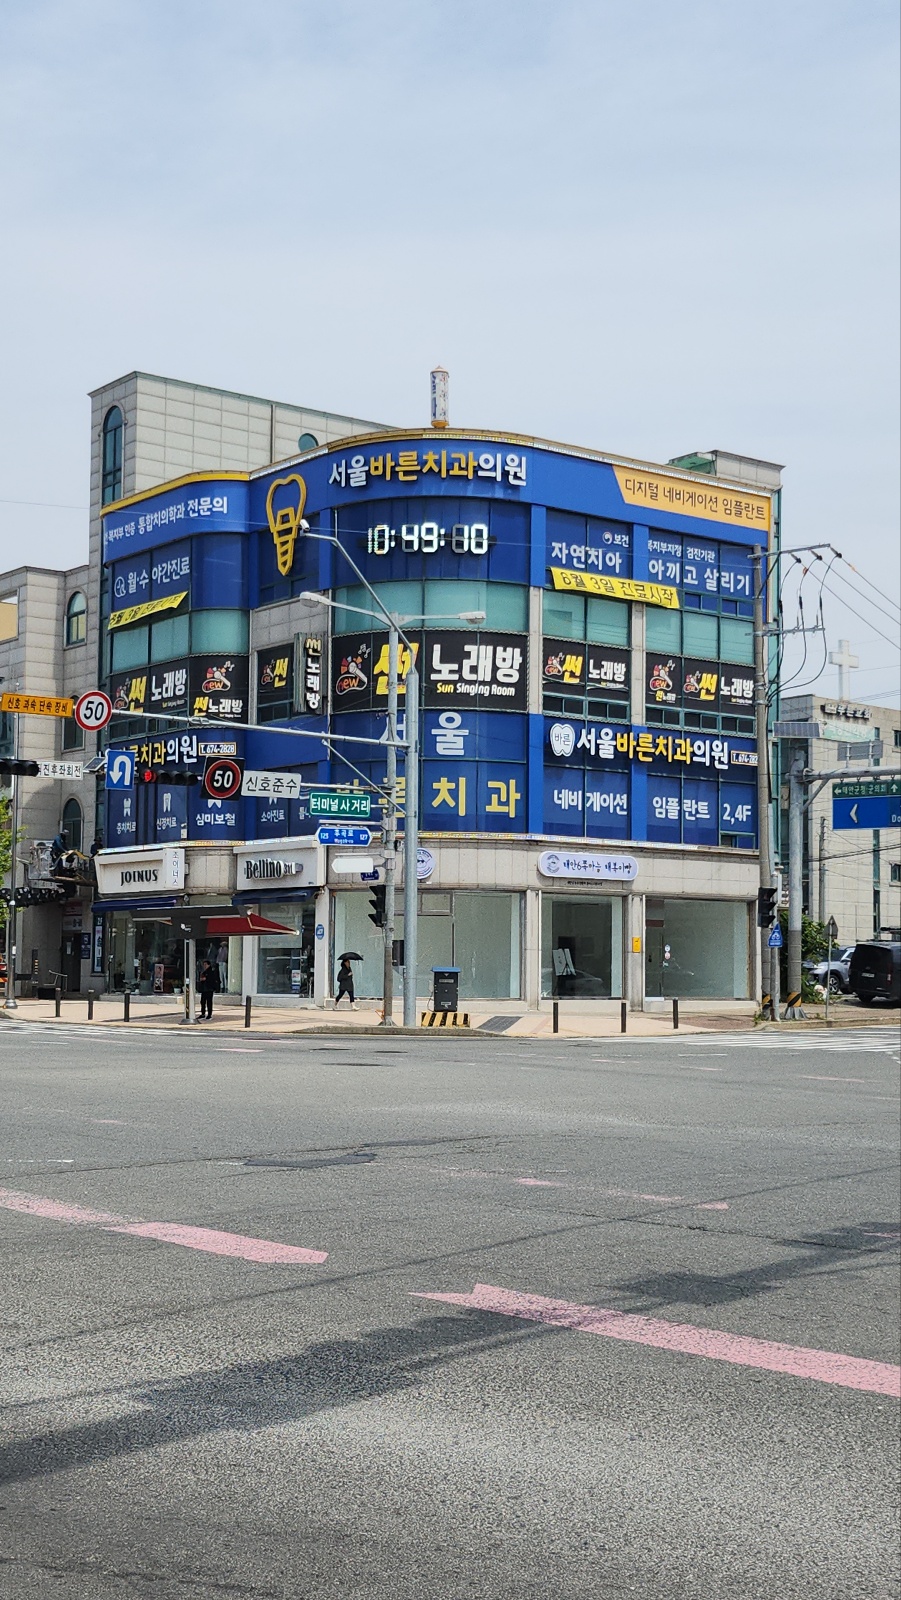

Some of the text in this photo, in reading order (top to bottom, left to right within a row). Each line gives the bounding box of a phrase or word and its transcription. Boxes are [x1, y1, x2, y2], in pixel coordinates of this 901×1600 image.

[328, 449, 527, 488] 서울바른치과의원
[625, 478, 766, 520] 디지털 네비게이션 임플란트
[138, 502, 185, 534] 통합치의학과
[187, 496, 228, 517] 전문의
[613, 534, 630, 547] 보건
[551, 541, 622, 573] 자연치아
[686, 546, 715, 563] 검진기관
[152, 556, 190, 584] 야간진료
[648, 559, 750, 596] 아끼고 살리기
[560, 571, 674, 606] 6월 3일 진료시작
[274, 657, 289, 688] 썬
[430, 644, 522, 683] 노래방
[562, 654, 627, 684] 썬 노래방
[129, 668, 187, 713] 썬 노래방
[436, 682, 515, 697] Sun Singing Room
[700, 672, 754, 700] 썬 노래방
[7, 697, 68, 714] 신호 과속 단속 장비
[83, 700, 104, 721] 50
[576, 727, 729, 770] 서울바른치과의원
[39, 763, 81, 777] 진후좌회전
[213, 770, 233, 788] 50
[245, 776, 298, 794] 신호준수
[195, 813, 236, 826] 심미보철
[260, 809, 285, 823] 소아진료
[722, 803, 752, 825] 2,4F
[120, 869, 158, 886] JOINUS
[245, 858, 282, 879] Bellino
